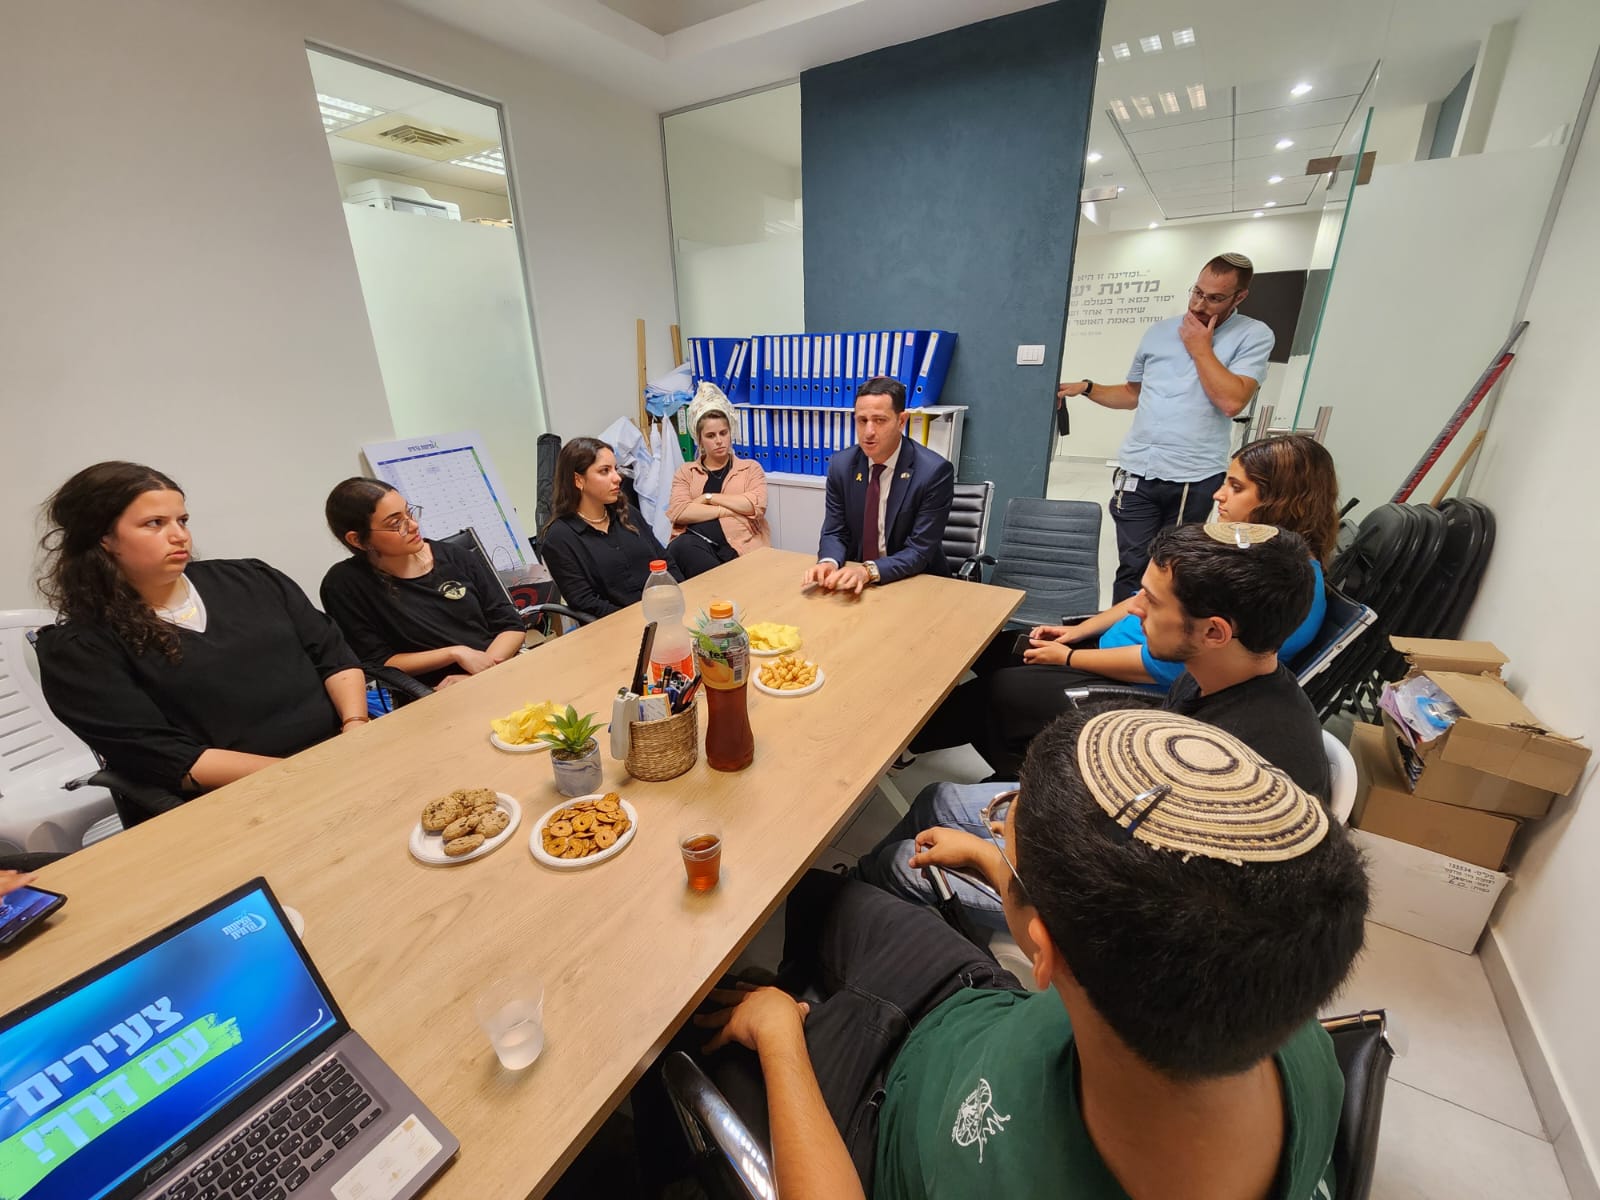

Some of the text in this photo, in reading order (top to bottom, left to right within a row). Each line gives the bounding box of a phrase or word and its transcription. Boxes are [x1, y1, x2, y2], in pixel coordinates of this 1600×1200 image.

[1072, 280, 1160, 297] מדינת יש
[1128, 296, 1150, 304] כסא
[1116, 307, 1146, 315] שיהיה
[1107, 317, 1136, 325] באמת
[6, 996, 184, 1117] צעירים
[21, 1027, 209, 1164] עם דרך!
